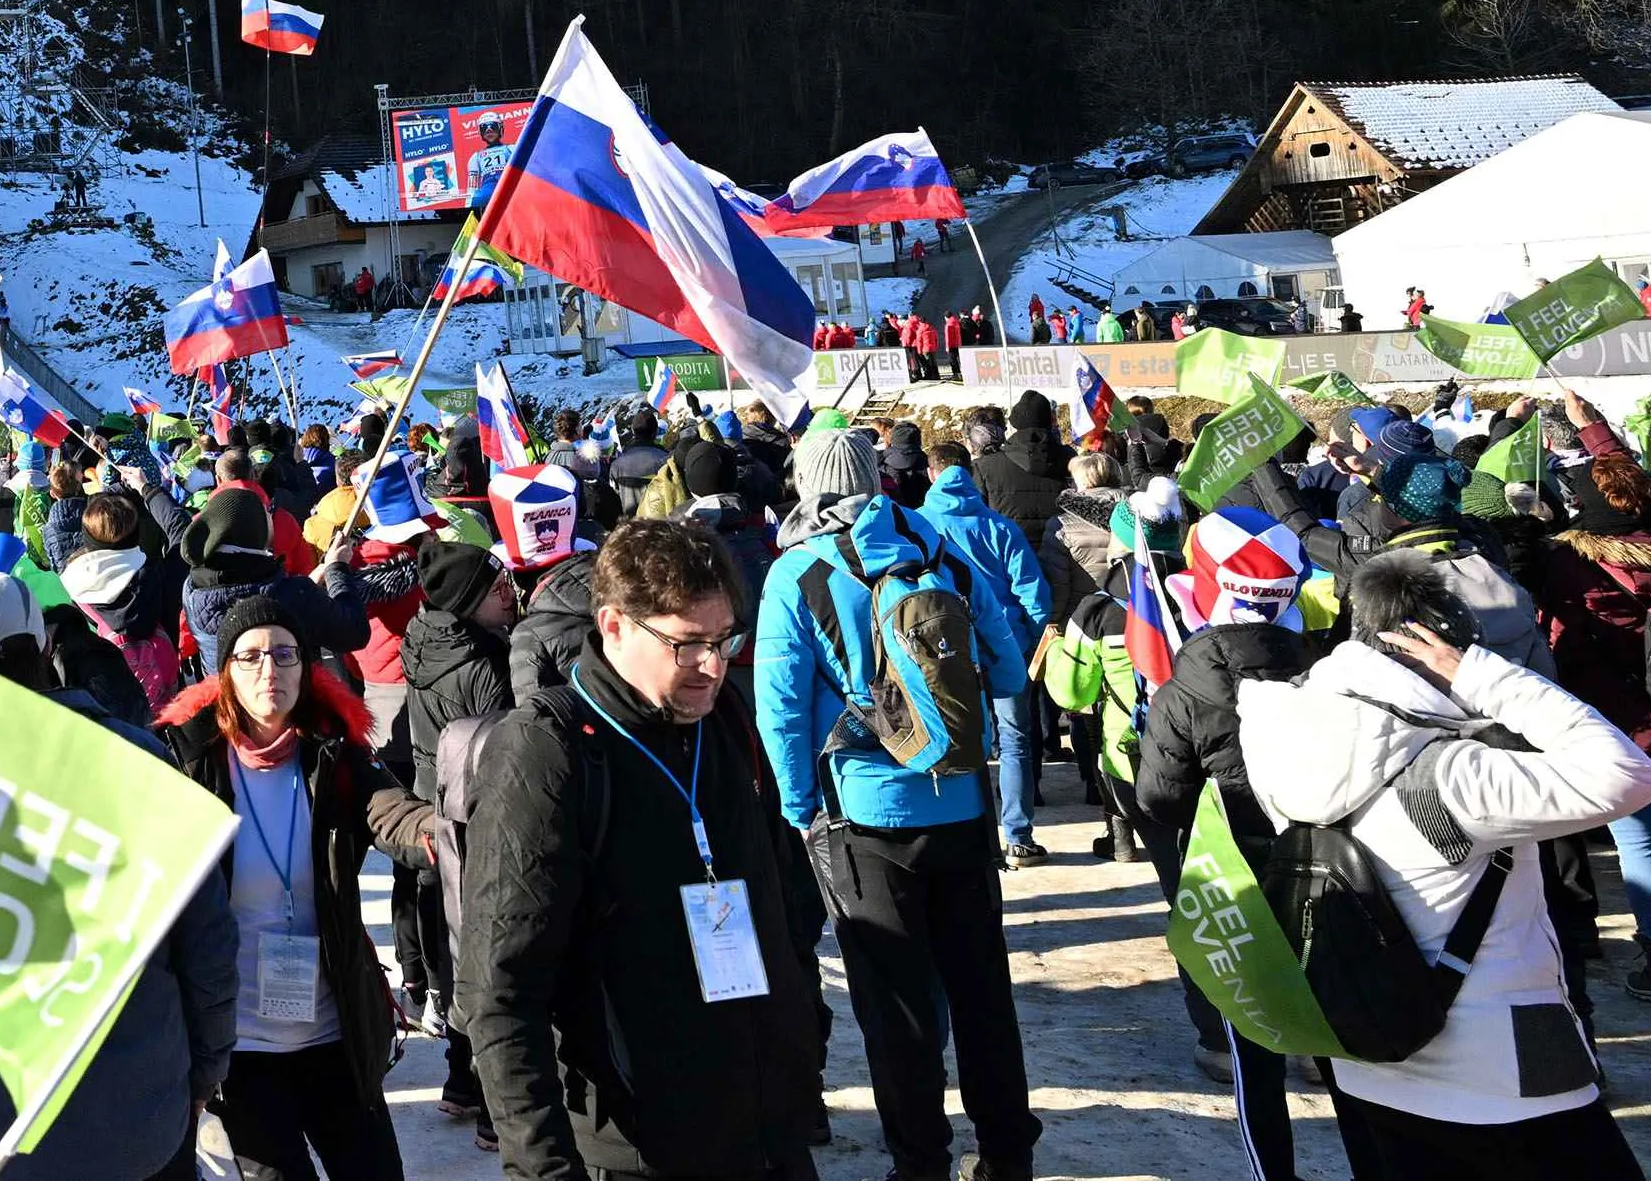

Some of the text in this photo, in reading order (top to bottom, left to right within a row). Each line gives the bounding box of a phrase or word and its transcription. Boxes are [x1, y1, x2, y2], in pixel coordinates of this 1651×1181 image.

[402, 119, 444, 139] HYLO
[405, 144, 447, 158] HYLO HYLO
[484, 155, 501, 167] 21
[1529, 298, 1575, 331] FEEL
[840, 352, 902, 371] RIHTER
[1003, 349, 1060, 375] Sintal
[522, 507, 571, 523] PLANICA
[1186, 851, 1259, 969] FEEL
